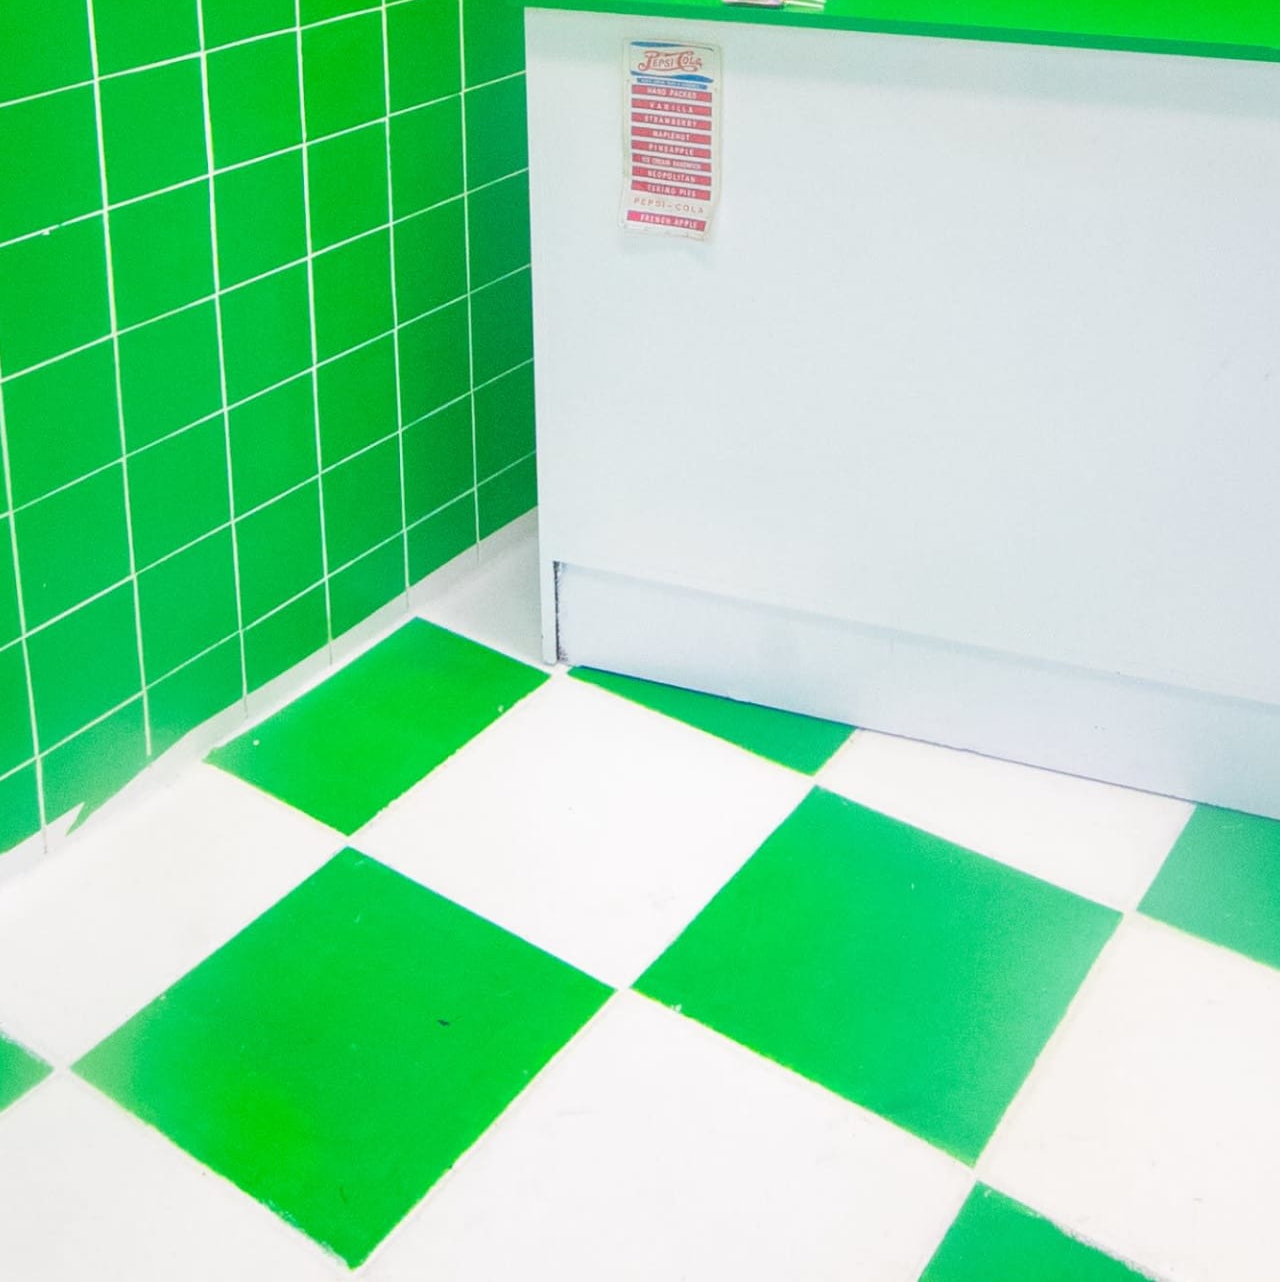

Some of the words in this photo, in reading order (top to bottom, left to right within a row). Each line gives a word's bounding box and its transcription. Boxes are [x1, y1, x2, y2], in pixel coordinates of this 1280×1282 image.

[647, 87, 667, 96] HAND
[649, 101, 694, 113] VANILLA
[644, 114, 697, 127] STRAWBERRY
[648, 143, 694, 156] PINEAPPLE
[674, 217, 698, 229] APPLE
